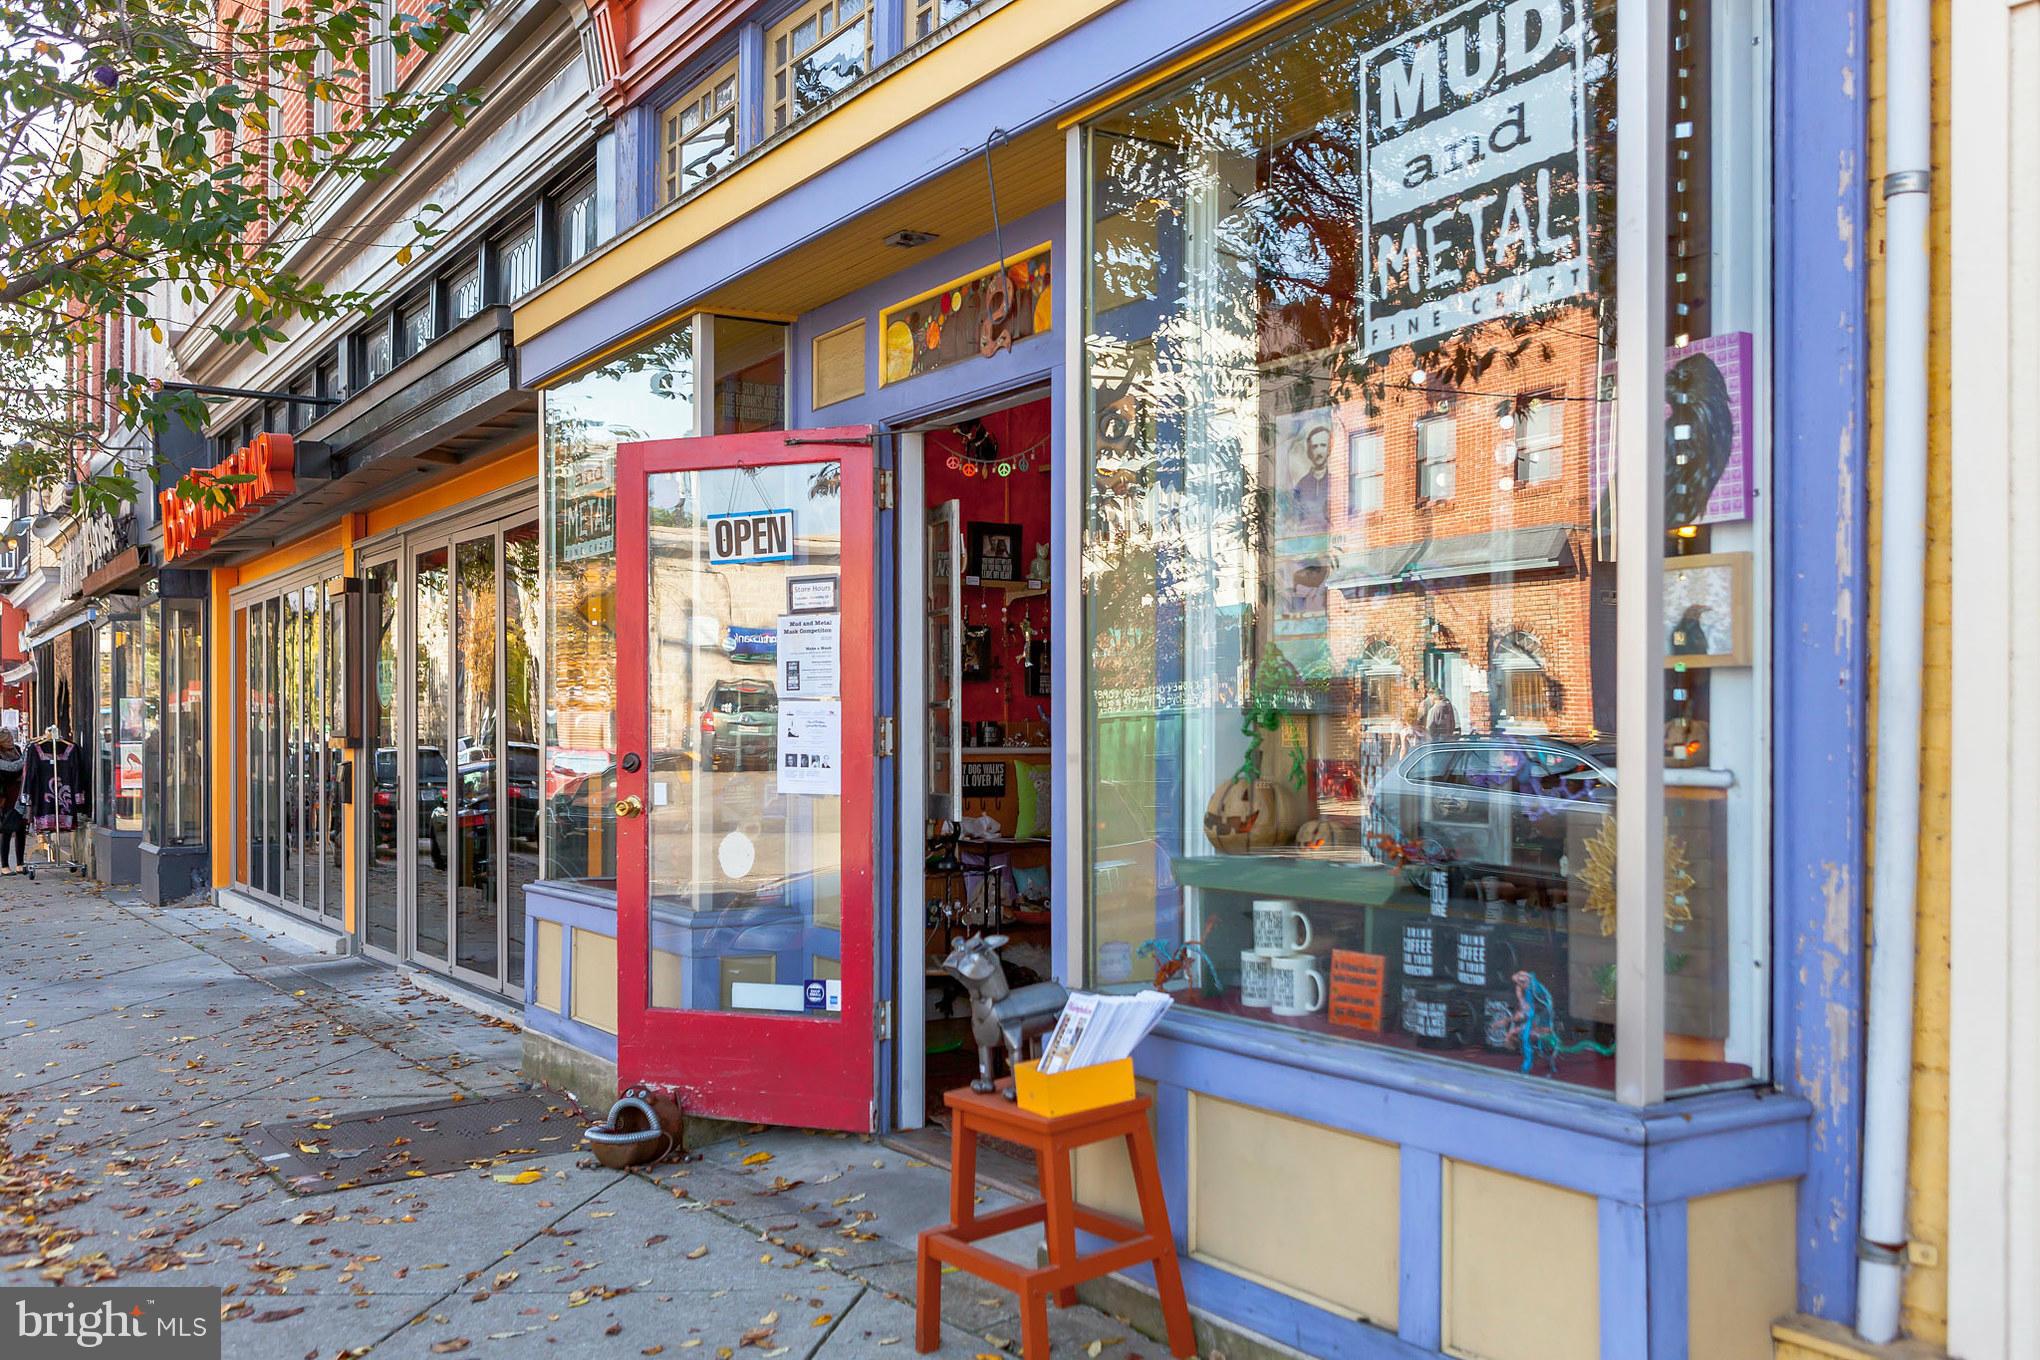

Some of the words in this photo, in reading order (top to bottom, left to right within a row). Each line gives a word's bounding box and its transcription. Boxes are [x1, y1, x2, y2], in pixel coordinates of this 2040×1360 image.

[1380, 0, 1562, 131] MUD
[1403, 102, 1531, 189] and
[1378, 168, 1573, 300] METAL
[1371, 309, 1441, 346] FINE
[1471, 268, 1580, 316] CRAFT
[568, 491, 611, 539] METAL
[715, 516, 787, 557] OPEN
[968, 764, 982, 774] DOG
[982, 764, 1005, 774] WALKS
[971, 775, 991, 786] OVER
[993, 774, 1004, 786] ME
